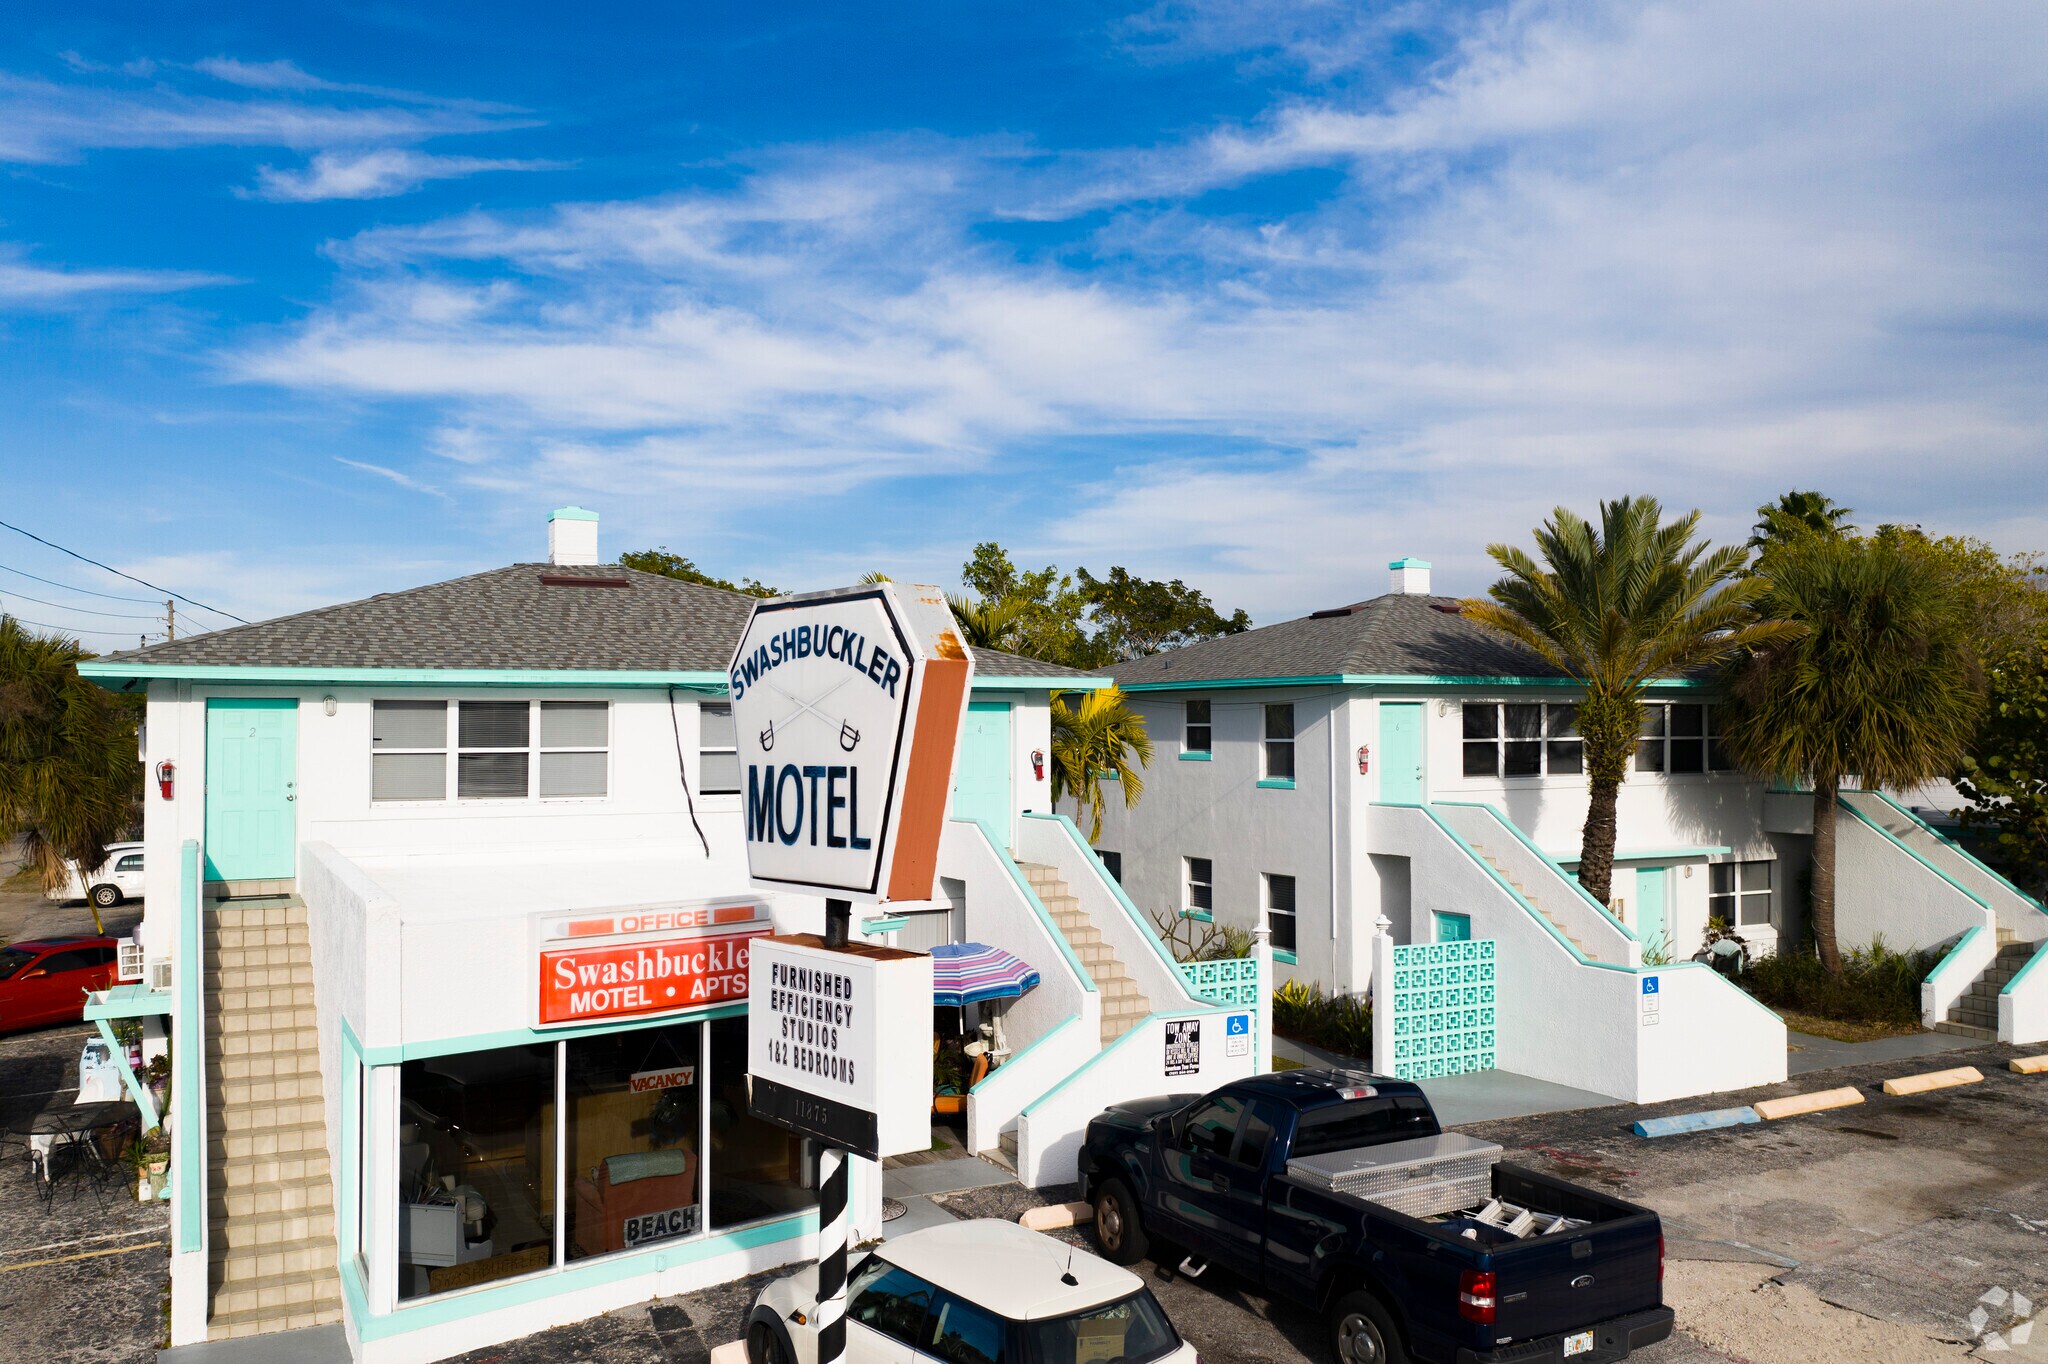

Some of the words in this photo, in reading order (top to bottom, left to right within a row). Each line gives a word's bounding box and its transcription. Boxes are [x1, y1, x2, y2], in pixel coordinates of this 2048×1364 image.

[731, 624, 900, 700] SWASHBUCKLER
[248, 727, 257, 738] 2
[748, 763, 871, 850] MOTEL
[620, 909, 709, 932] OFFICE
[555, 941, 749, 990] Swashbuckle
[771, 962, 853, 1001] FURNISHED
[570, 985, 652, 1014] MOTEL
[770, 988, 853, 1028] EFFICIENCY
[782, 1015, 838, 1052] STUDIOS
[1166, 1022, 1180, 1034] TOW
[1182, 1021, 1199, 1033] AWAY
[1174, 1032, 1191, 1044] ZONE
[768, 1037, 788, 1066] 1&2
[793, 1046, 855, 1085] BEDROOMS
[630, 1071, 693, 1092] VACANCY
[795, 1099, 827, 1125] 11875
[627, 1207, 696, 1241] BEACH
